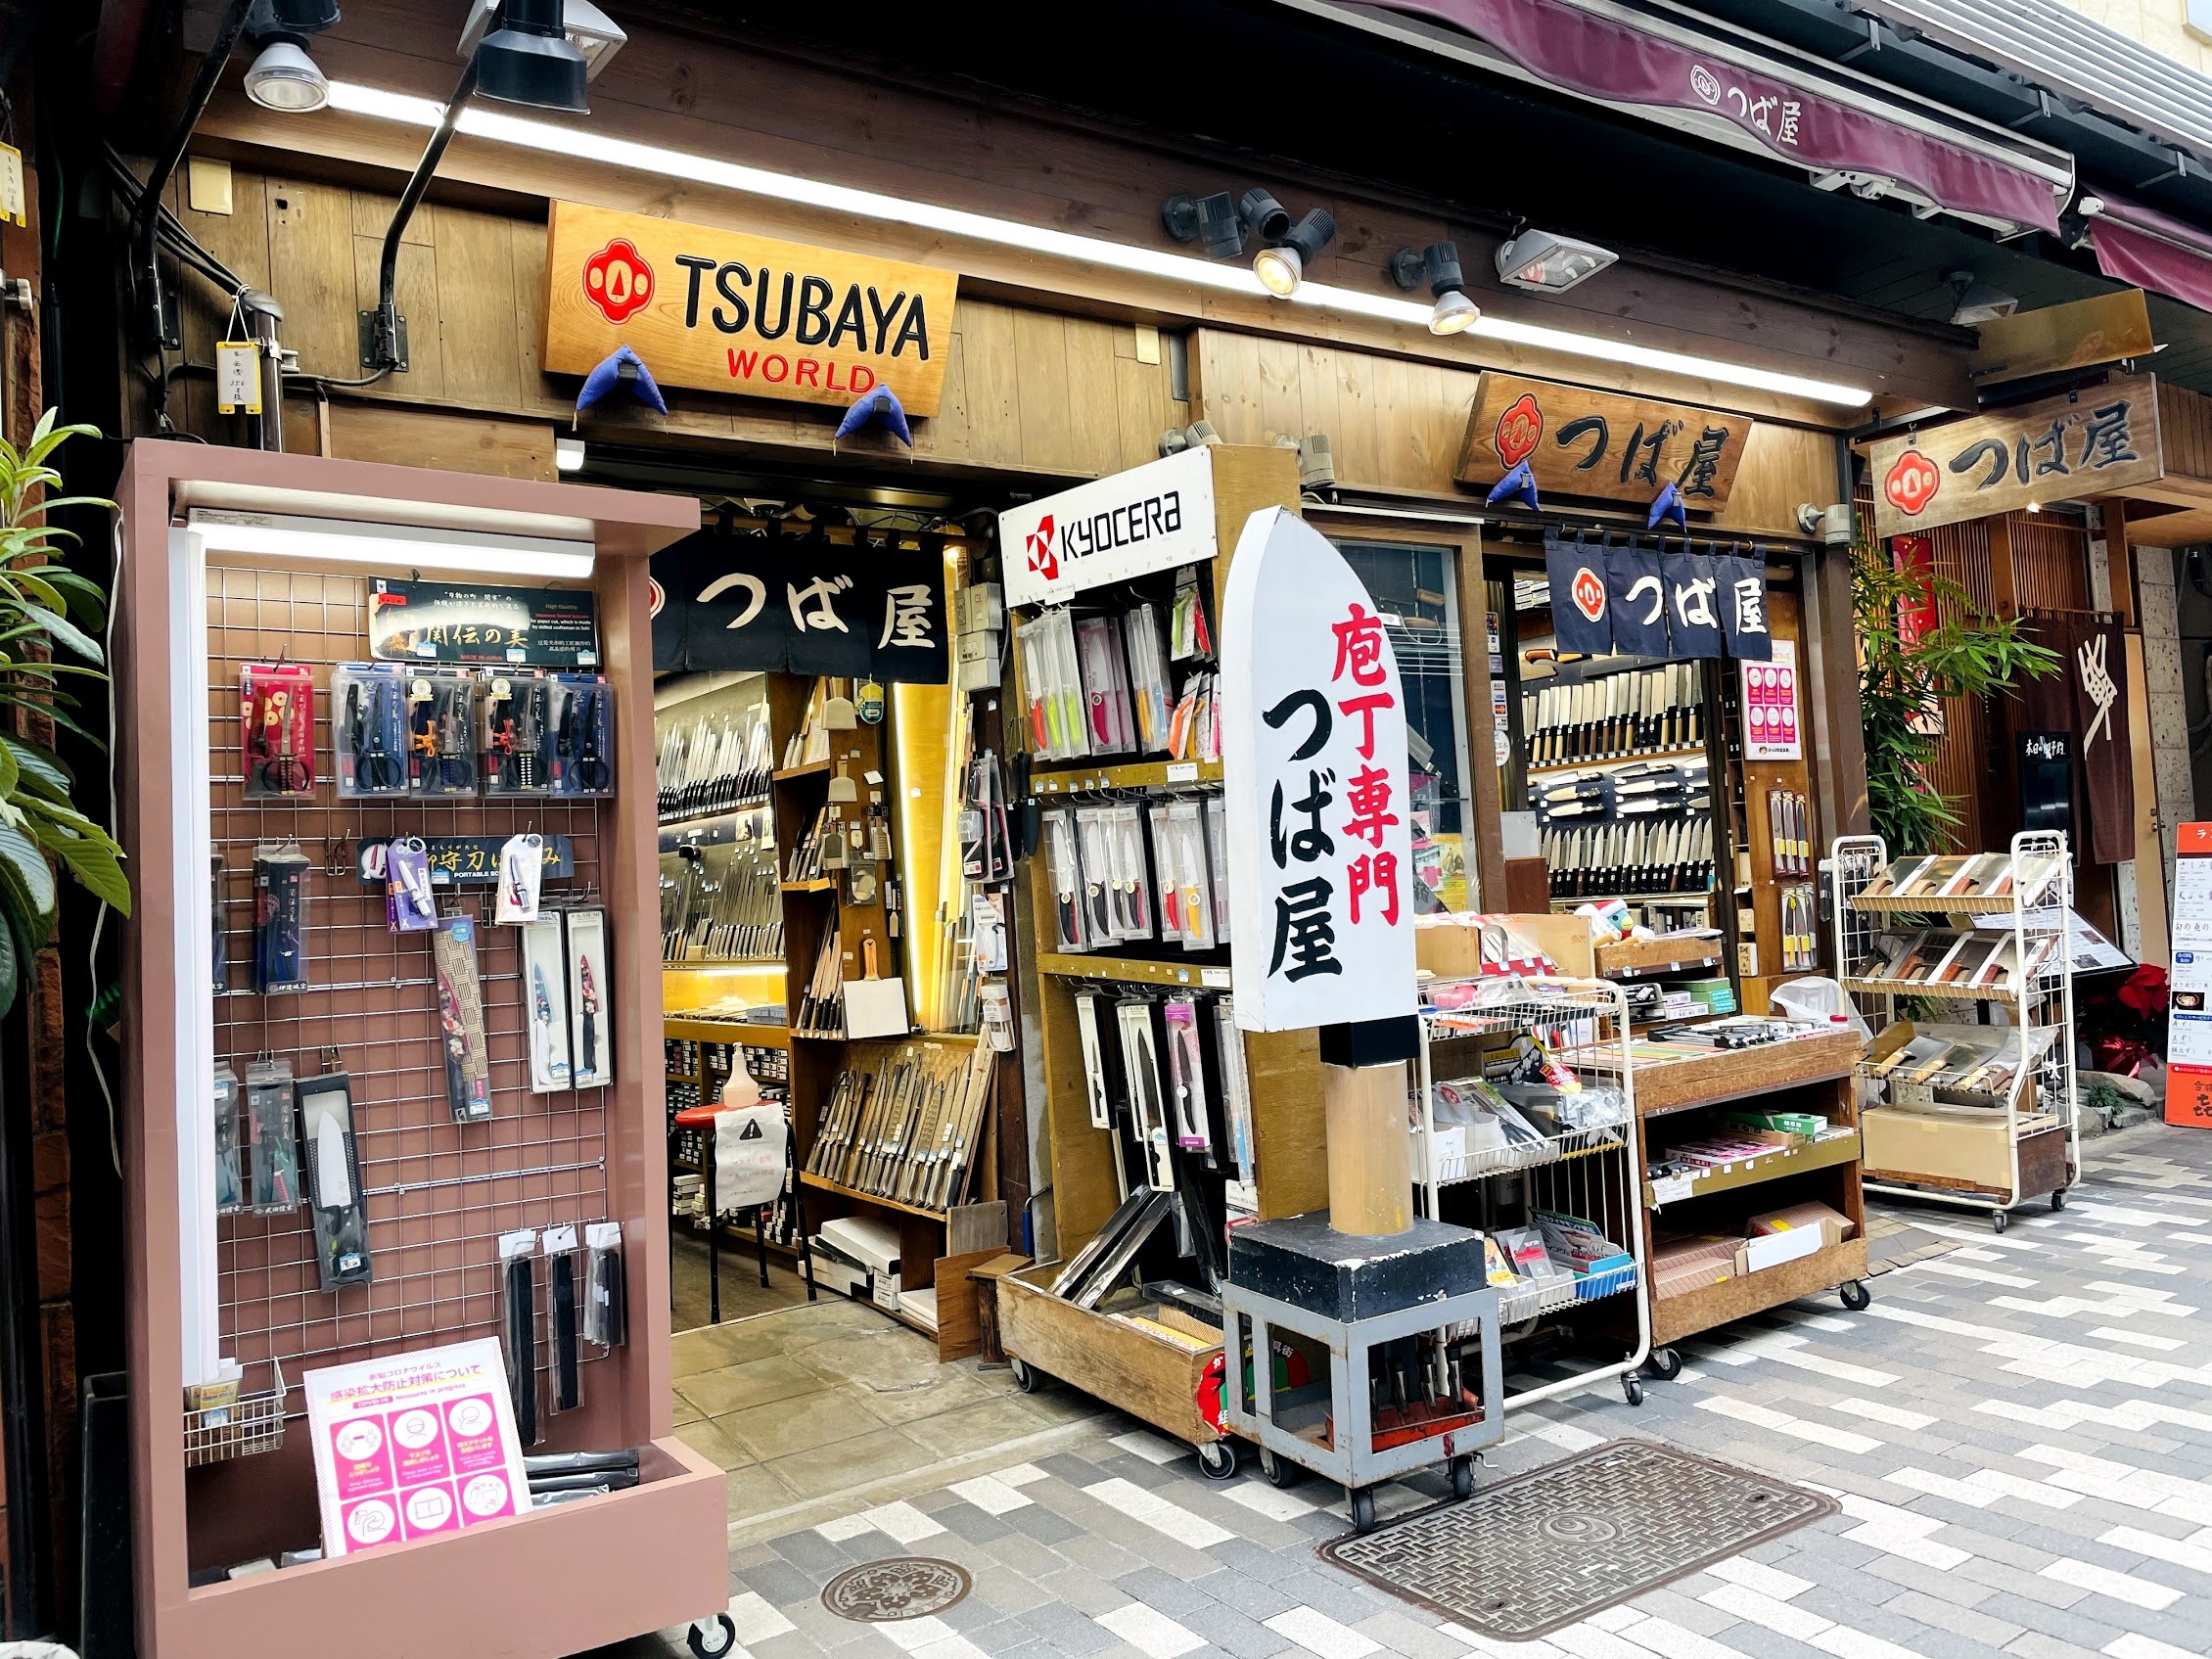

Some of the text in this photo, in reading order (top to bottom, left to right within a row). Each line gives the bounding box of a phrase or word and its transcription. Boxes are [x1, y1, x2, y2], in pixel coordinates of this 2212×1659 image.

[1728, 86, 1801, 145] つば屋
[675, 254, 930, 361] TSUBAYA
[727, 347, 875, 393] WORLD
[1556, 415, 1729, 499] つば屋
[1949, 399, 2140, 492] つば屋
[1060, 490, 1182, 562] KYOCERA
[697, 573, 936, 650] つば屋
[1626, 576, 1768, 636] つば屋
[1331, 603, 1400, 928] 庖丁専門
[1262, 689, 1343, 983] つば屋
[330, 1363, 482, 1402] 感染拡大防止対策について
[357, 1397, 390, 1407] COVID-19
[395, 1390, 428, 1401] Measures
[368, 1361, 441, 1381] 新型コロナウイルス
